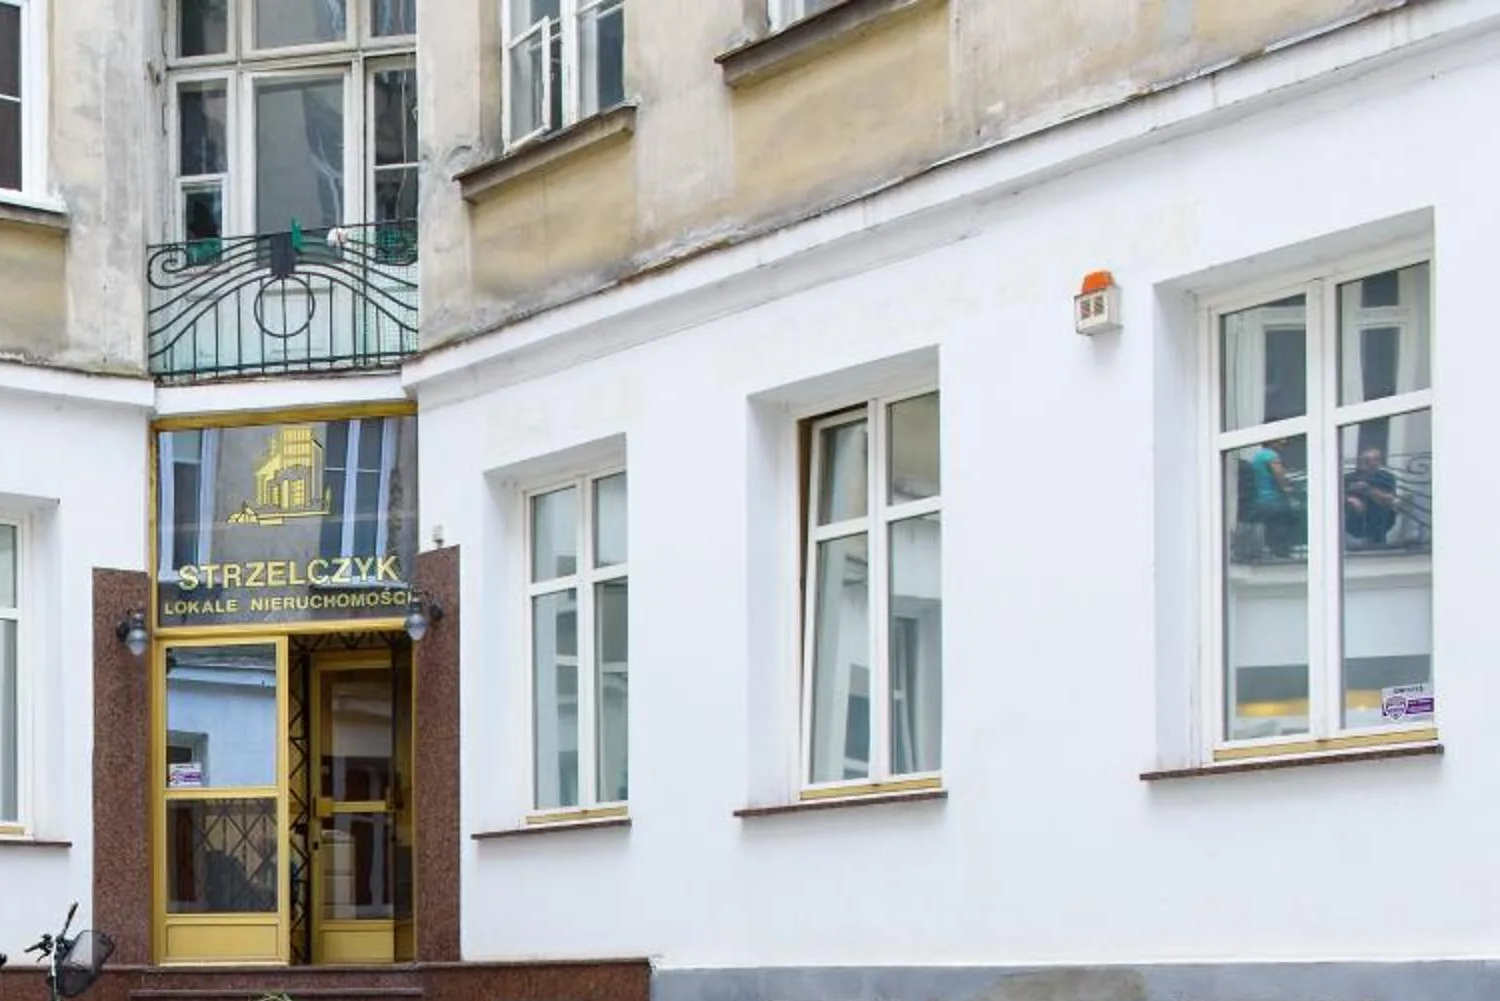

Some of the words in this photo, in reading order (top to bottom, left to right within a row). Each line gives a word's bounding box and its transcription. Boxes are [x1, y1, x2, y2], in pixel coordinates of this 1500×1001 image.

[178, 555, 399, 591] STRZELCZYK
[164, 598, 239, 615] LOKALE
[250, 588, 412, 611] NIERUCHOMOŚCI
